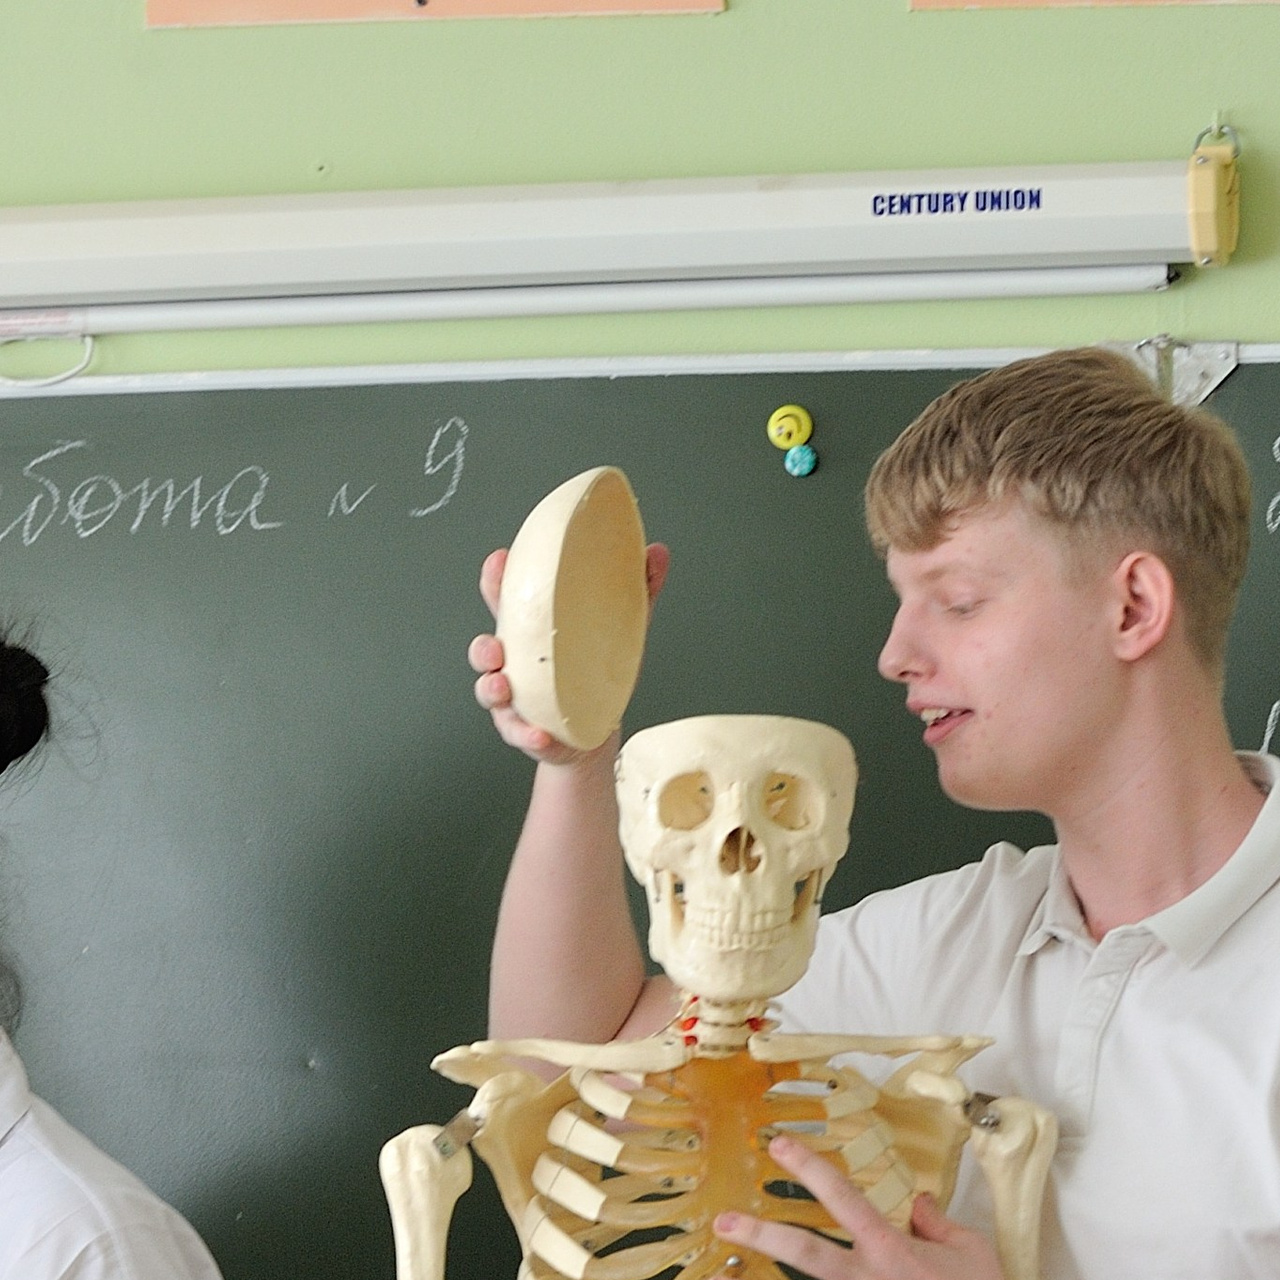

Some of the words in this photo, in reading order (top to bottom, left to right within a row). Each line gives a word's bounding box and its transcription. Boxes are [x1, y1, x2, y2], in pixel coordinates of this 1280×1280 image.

[872, 191, 969, 216] CENTURY
[975, 188, 1042, 212] UNION
[410, 416, 470, 517] 9
